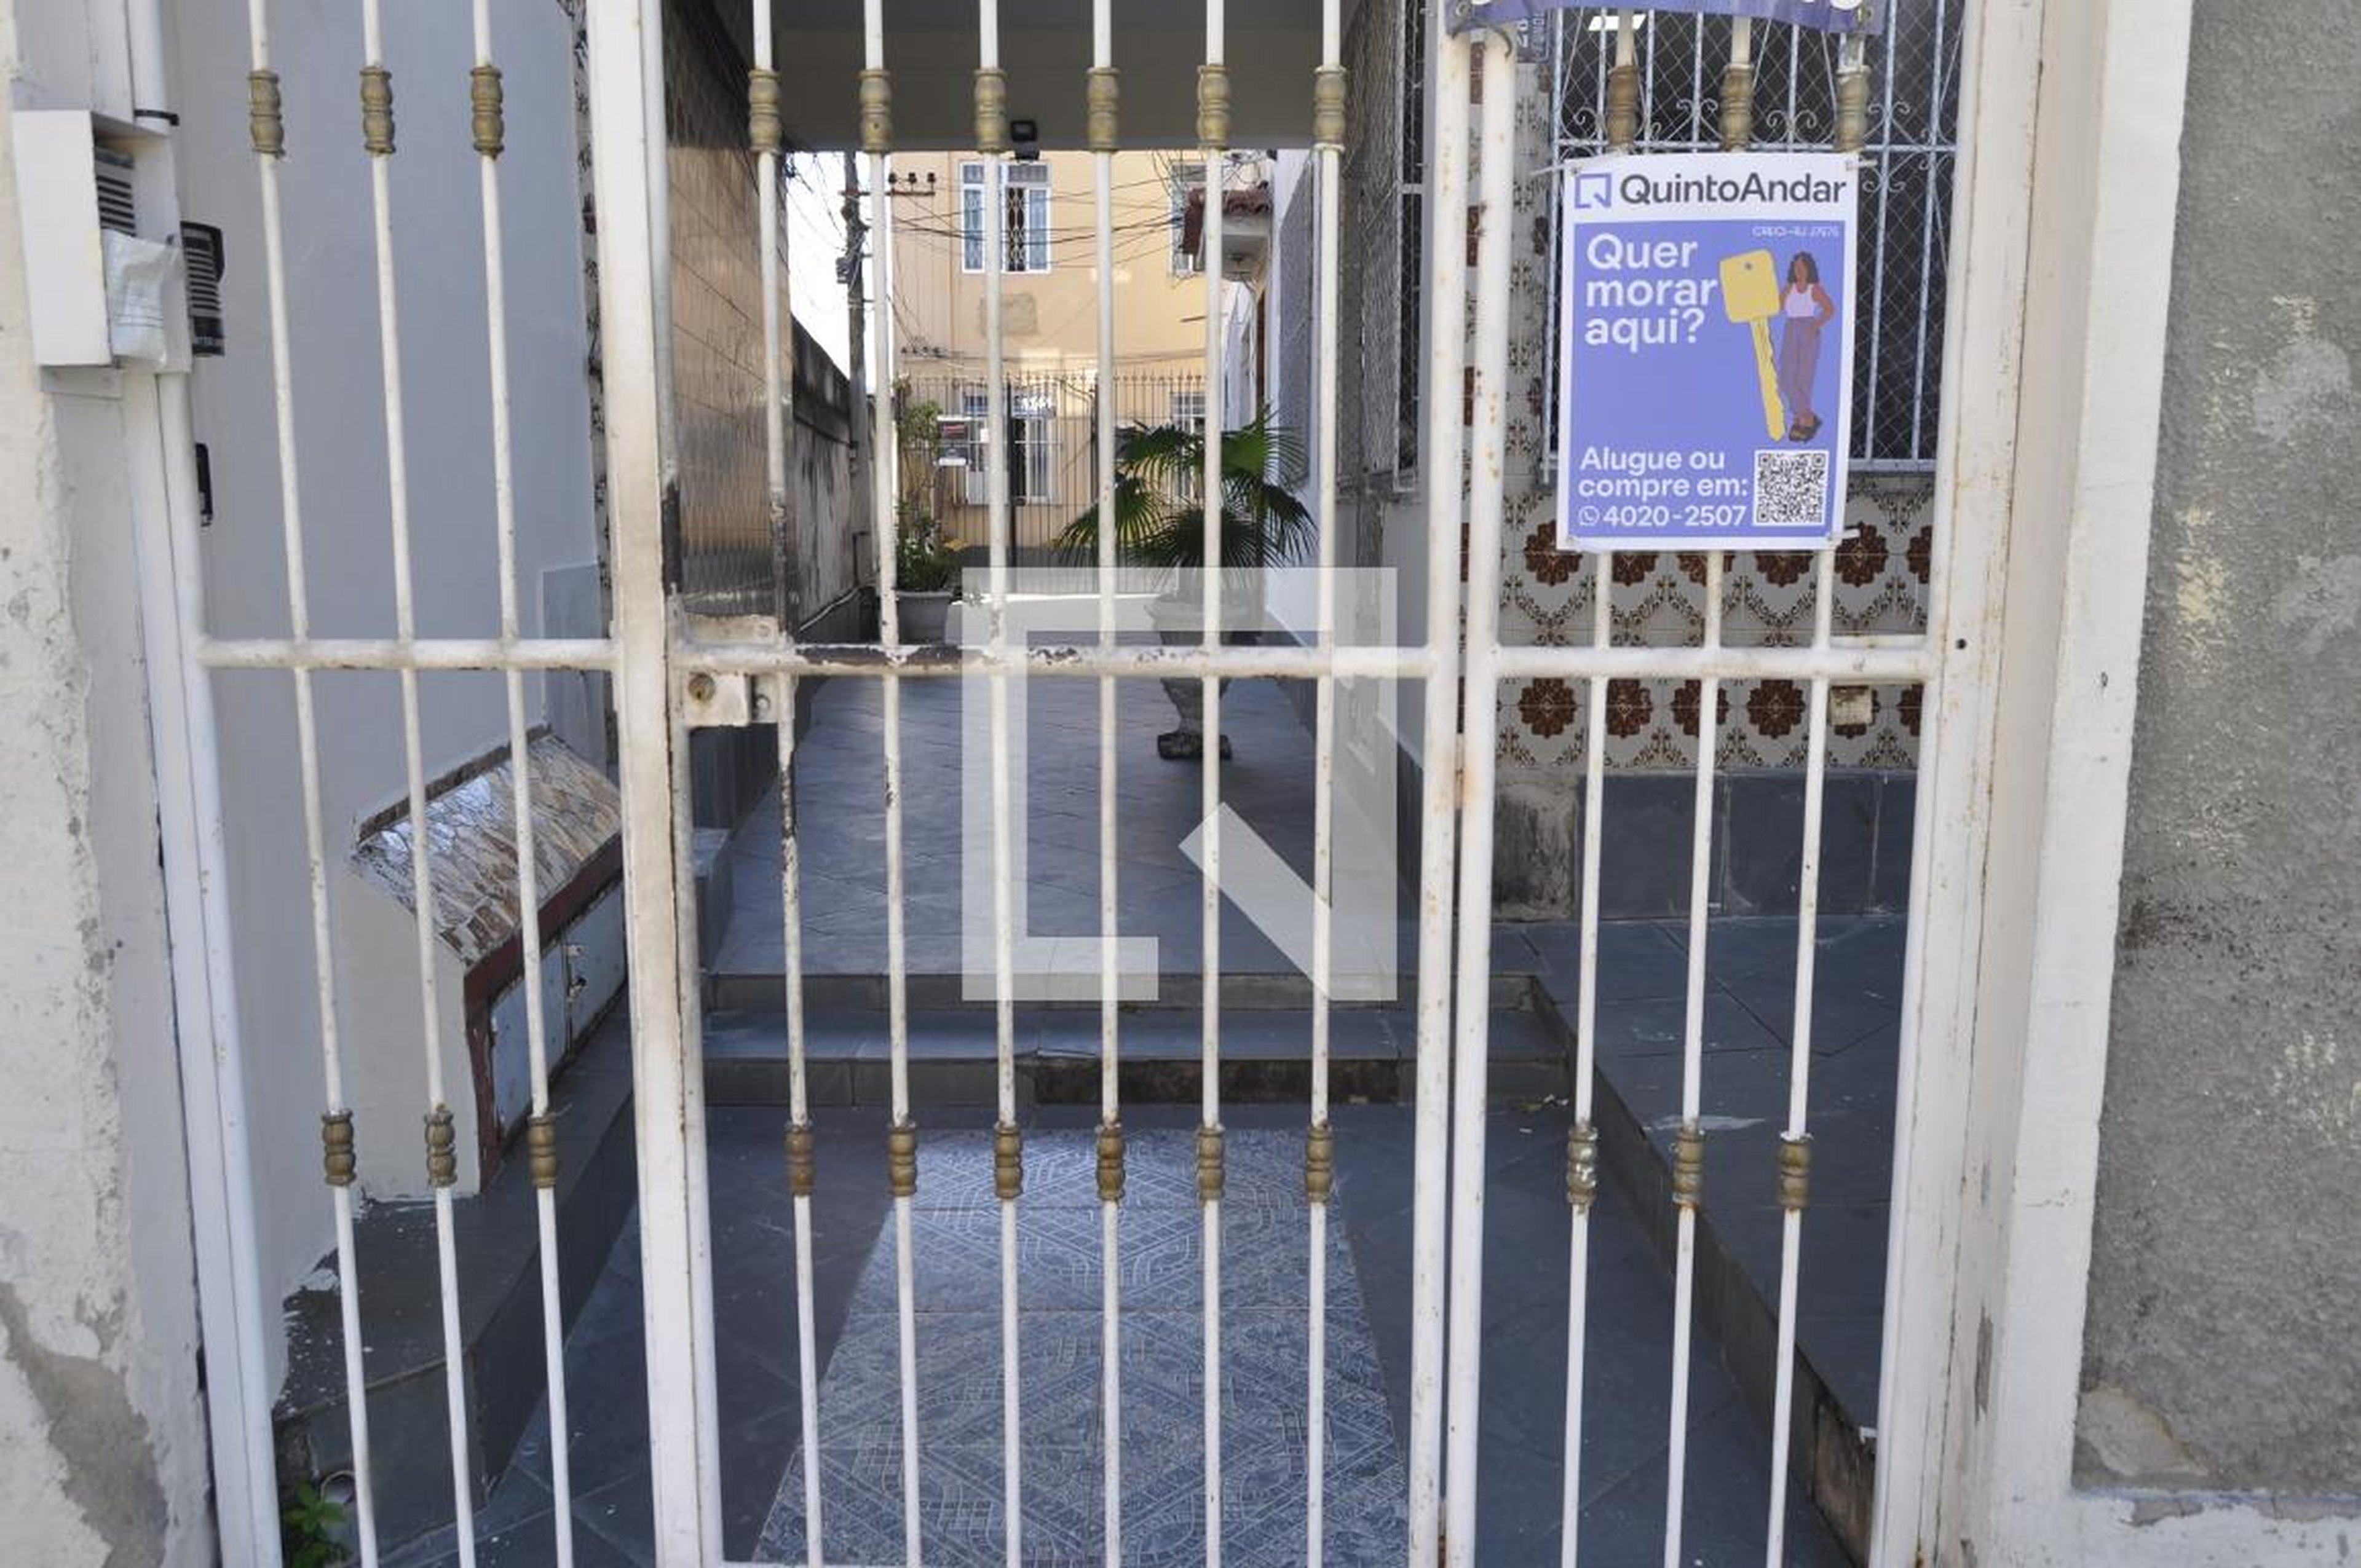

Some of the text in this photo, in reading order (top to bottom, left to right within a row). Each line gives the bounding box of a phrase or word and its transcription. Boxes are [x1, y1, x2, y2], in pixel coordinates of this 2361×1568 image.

[1620, 173, 1846, 204] QuintoAndar
[1586, 233, 1698, 270] Quer
[1586, 280, 1717, 307] morar
[1584, 309, 1705, 353] aqui?
[1580, 446, 1725, 476] Alugue ou
[1578, 477, 1748, 502] compre em:
